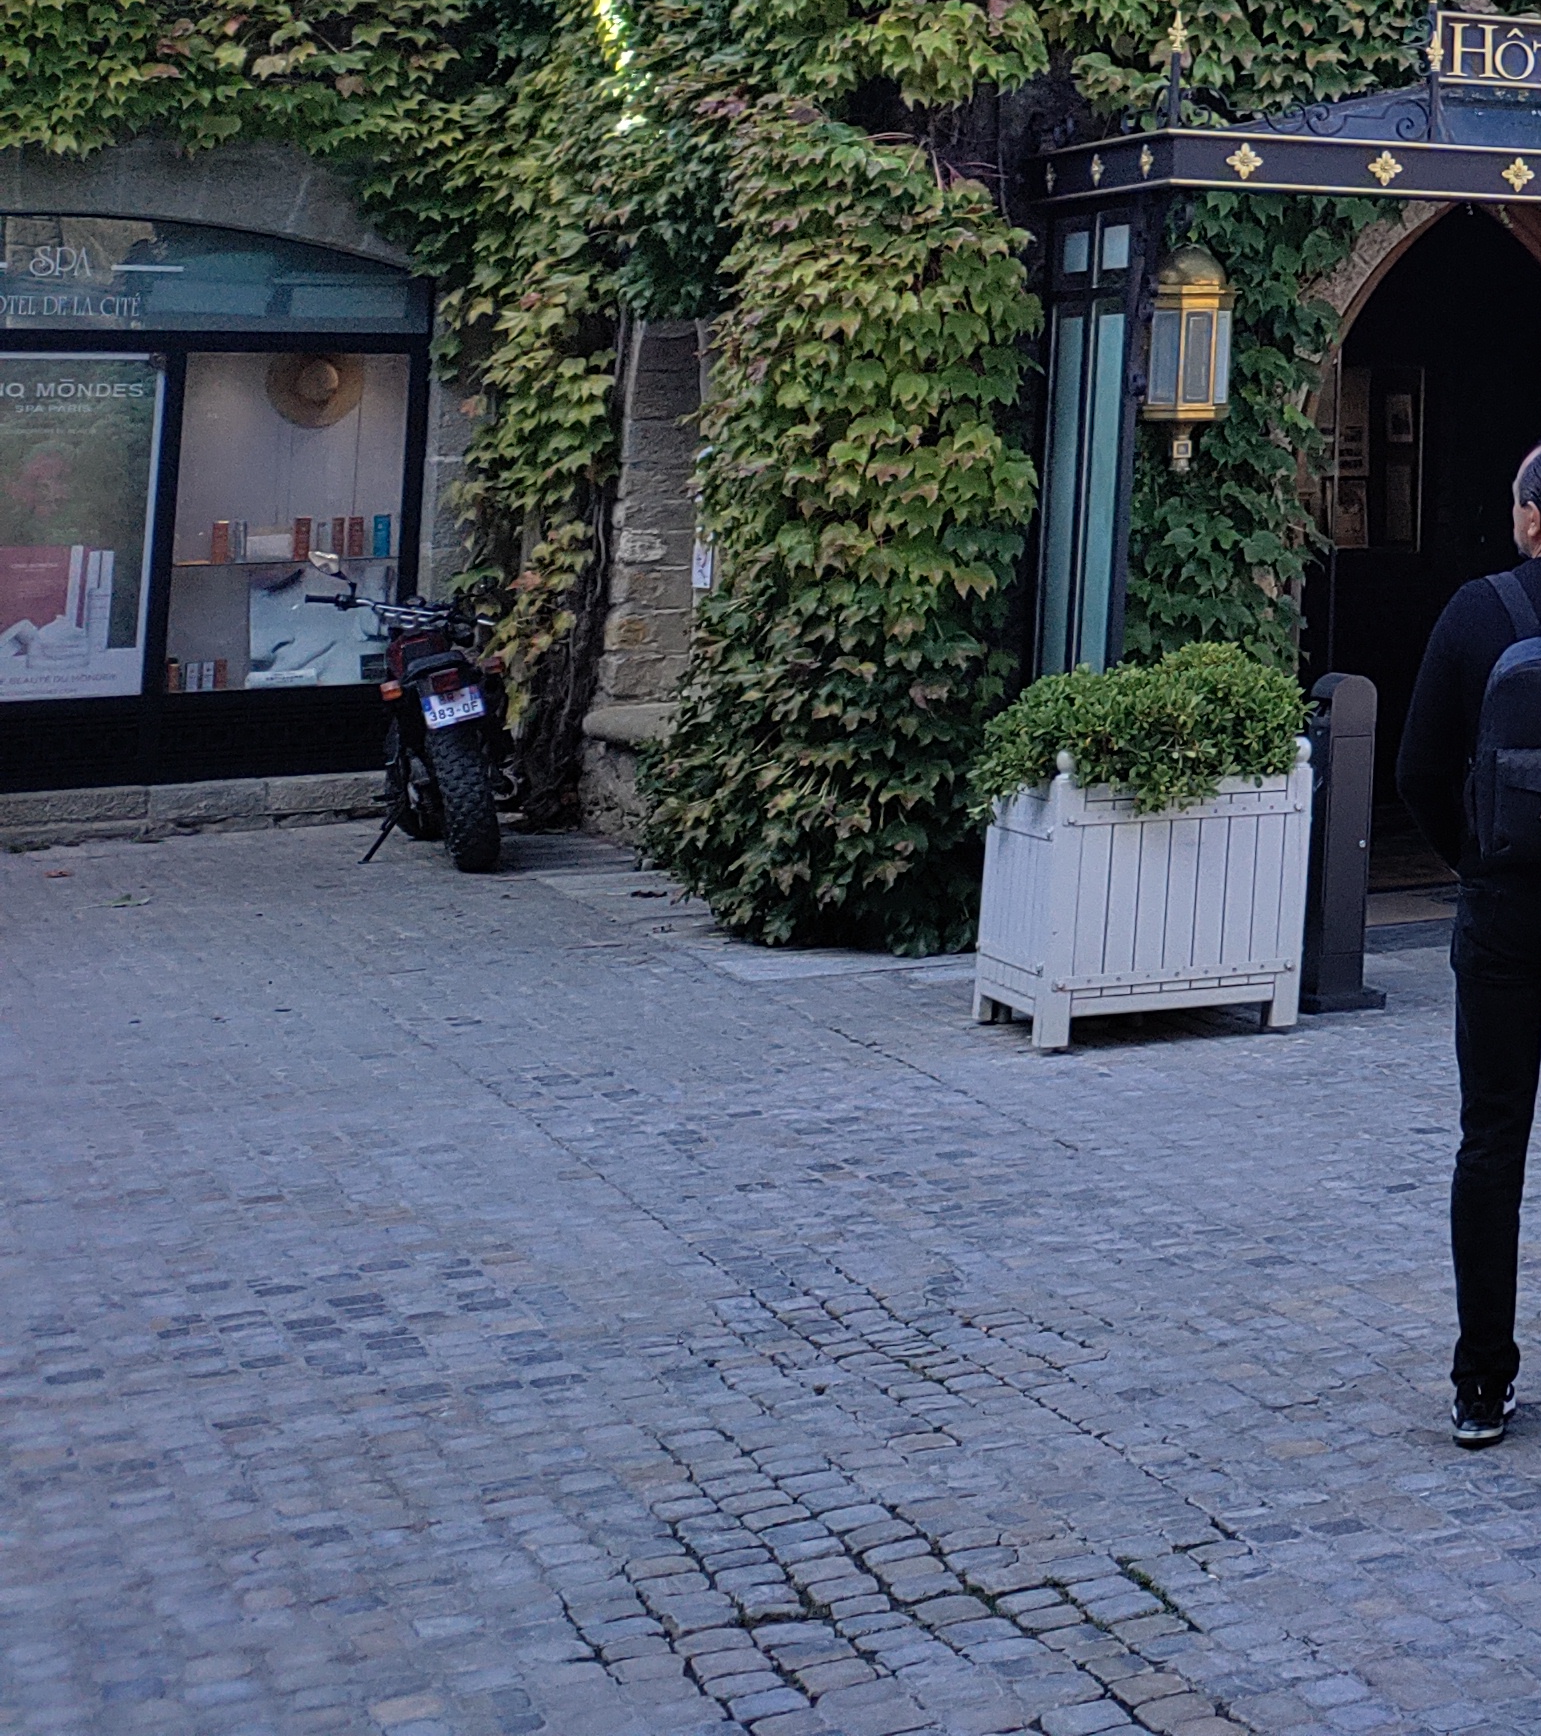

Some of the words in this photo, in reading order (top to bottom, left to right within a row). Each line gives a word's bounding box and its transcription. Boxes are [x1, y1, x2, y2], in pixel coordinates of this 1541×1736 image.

[29, 245, 92, 277] SPA
[43, 295, 68, 316] DE
[73, 296, 94, 316] LA
[100, 292, 142, 317] CITÉ
[0, 382, 25, 399] Q
[15, 404, 44, 413] SPA
[48, 404, 92, 413] PARIS
